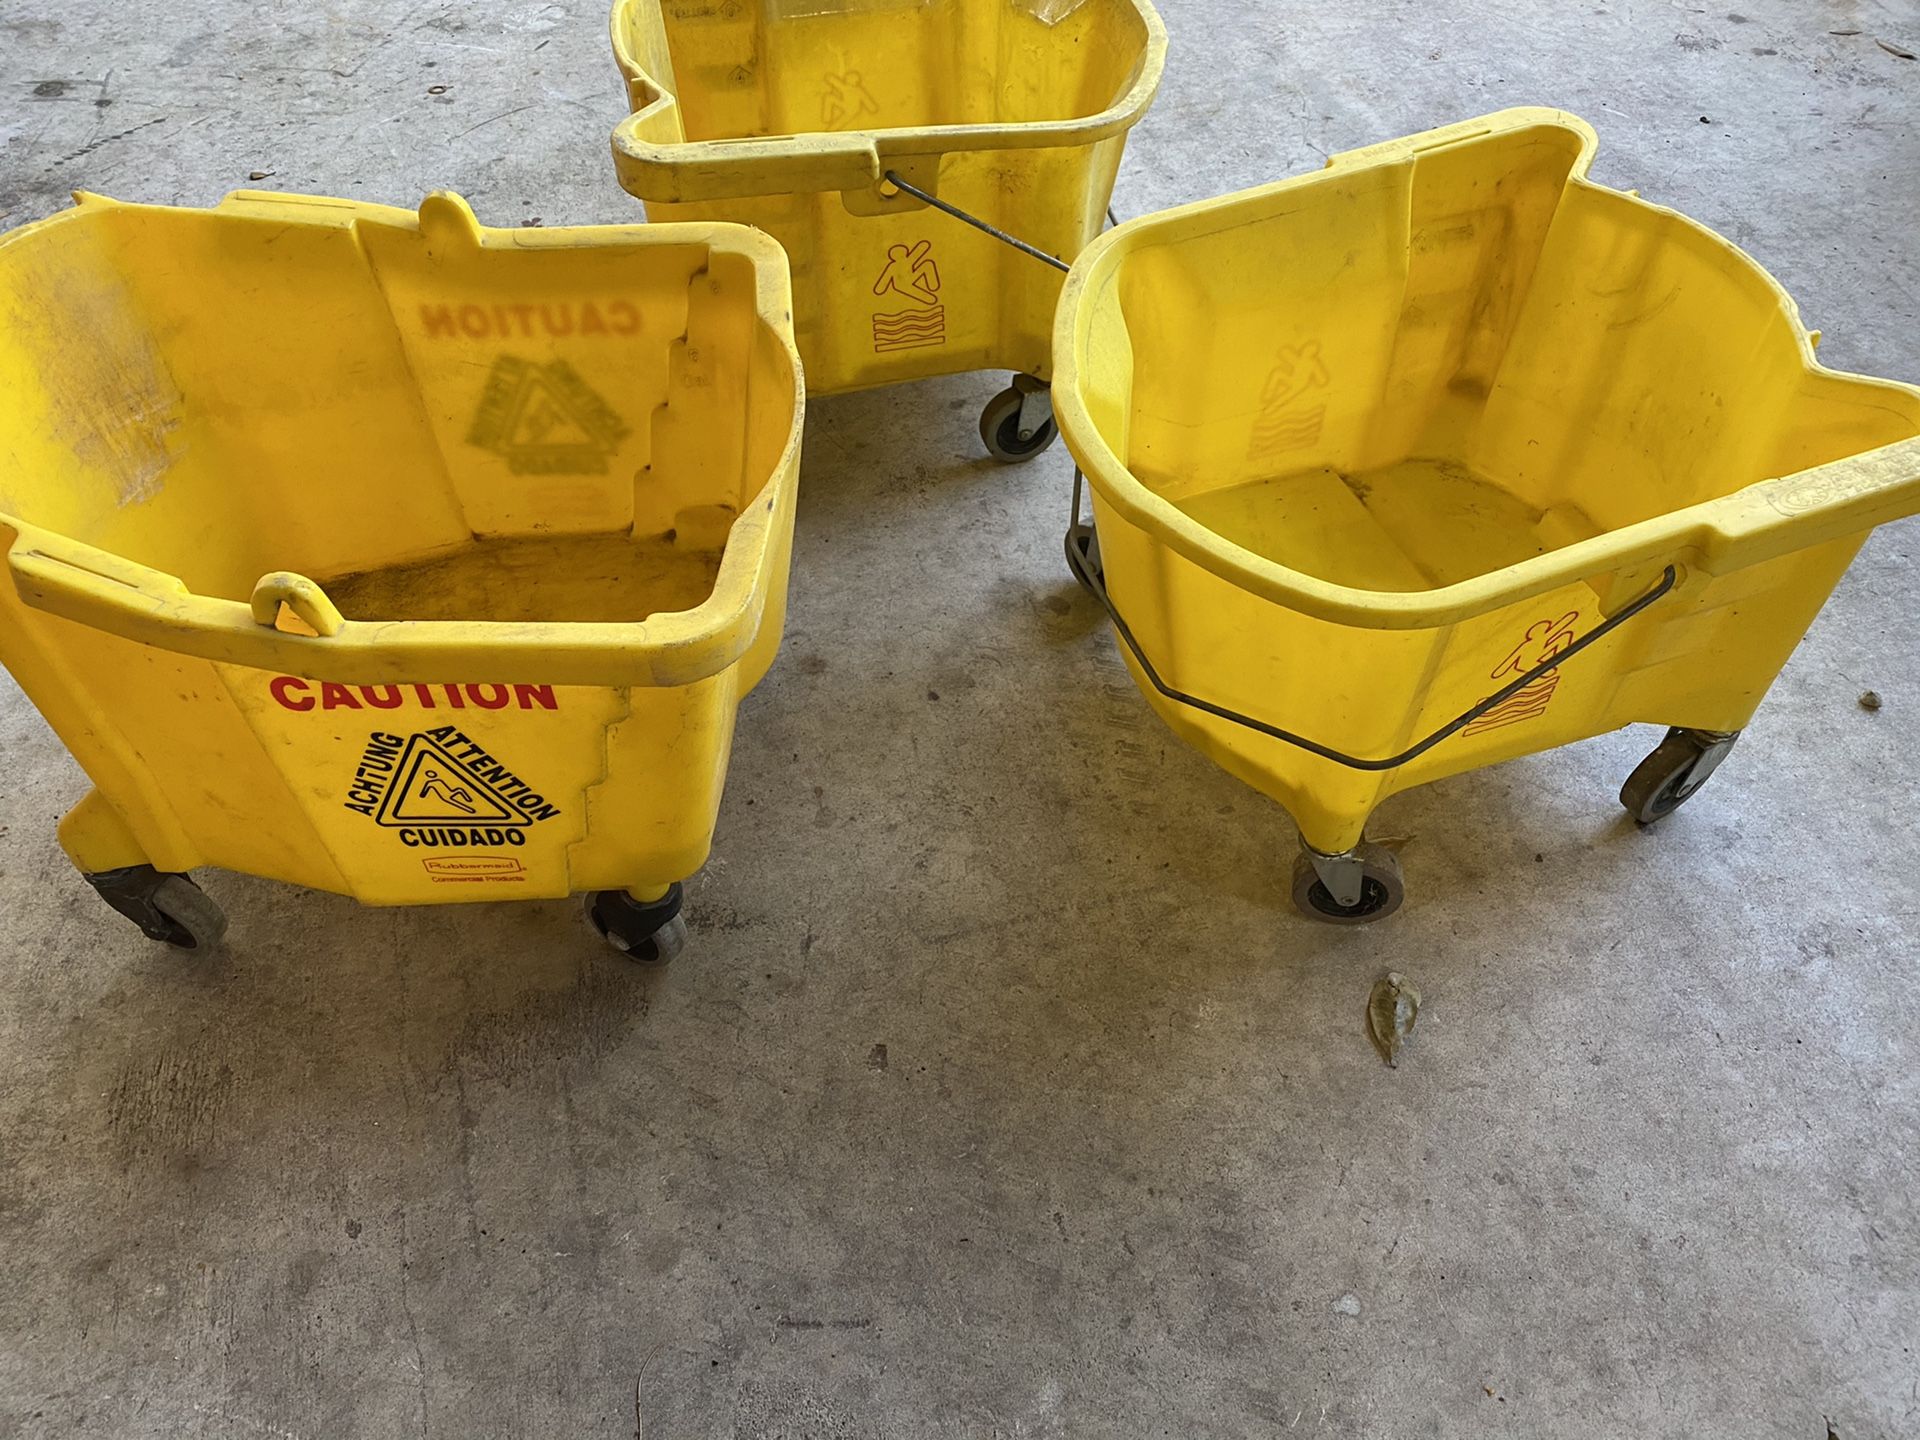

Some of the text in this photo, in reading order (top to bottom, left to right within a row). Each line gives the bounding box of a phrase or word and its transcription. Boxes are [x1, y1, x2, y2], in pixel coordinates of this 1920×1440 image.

[344, 731, 404, 816] ACHTUNG
[425, 725, 561, 821] ATTENTION
[399, 828, 526, 847] CUIDADO
[429, 861, 514, 870] Rubbermaid
